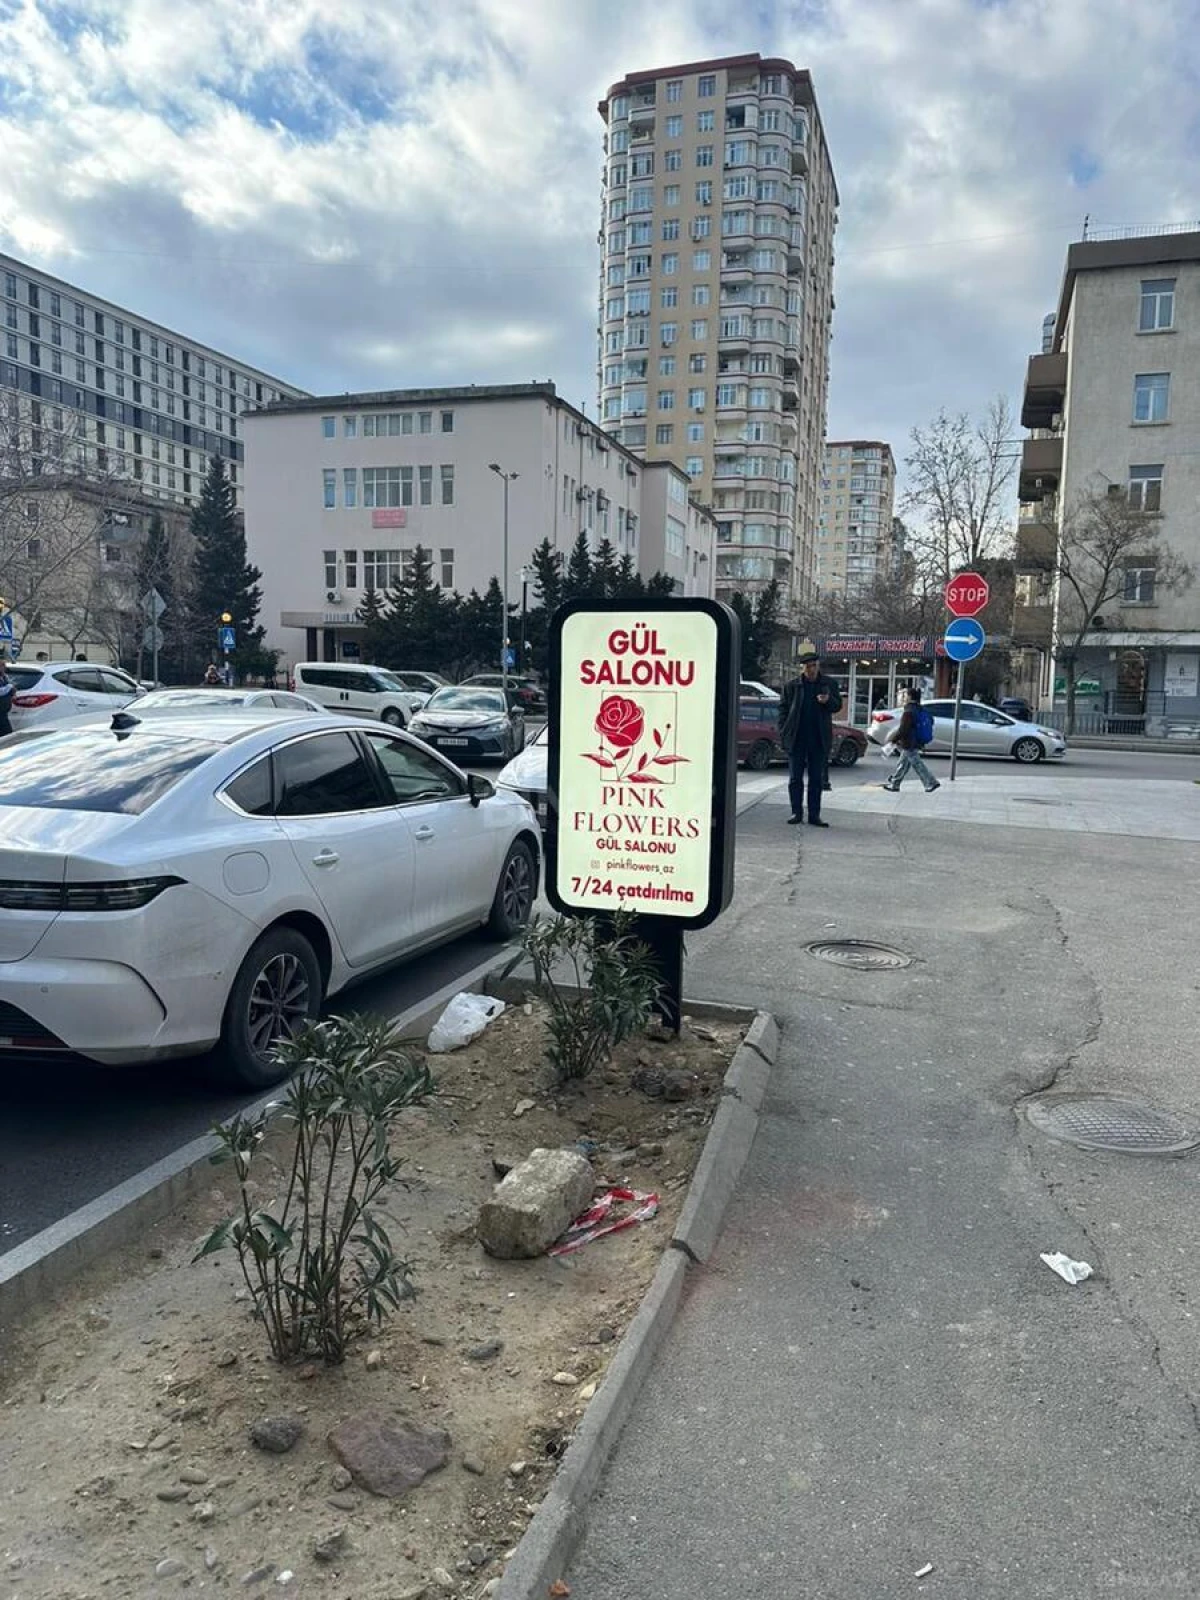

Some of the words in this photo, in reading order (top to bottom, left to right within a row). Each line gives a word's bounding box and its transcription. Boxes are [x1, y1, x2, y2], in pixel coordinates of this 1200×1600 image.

[948, 587, 986, 602] STOP
[608, 622, 666, 656] GÜL
[579, 659, 695, 687] SALONU
[602, 786, 665, 809] PINK
[575, 811, 699, 838] FLOWERS
[595, 836, 621, 851] GÜL
[624, 840, 677, 855] SALONU
[606, 859, 675, 875] pinkflowers_az
[572, 875, 612, 897] 7/24
[616, 882, 694, 904] çatdırılma
